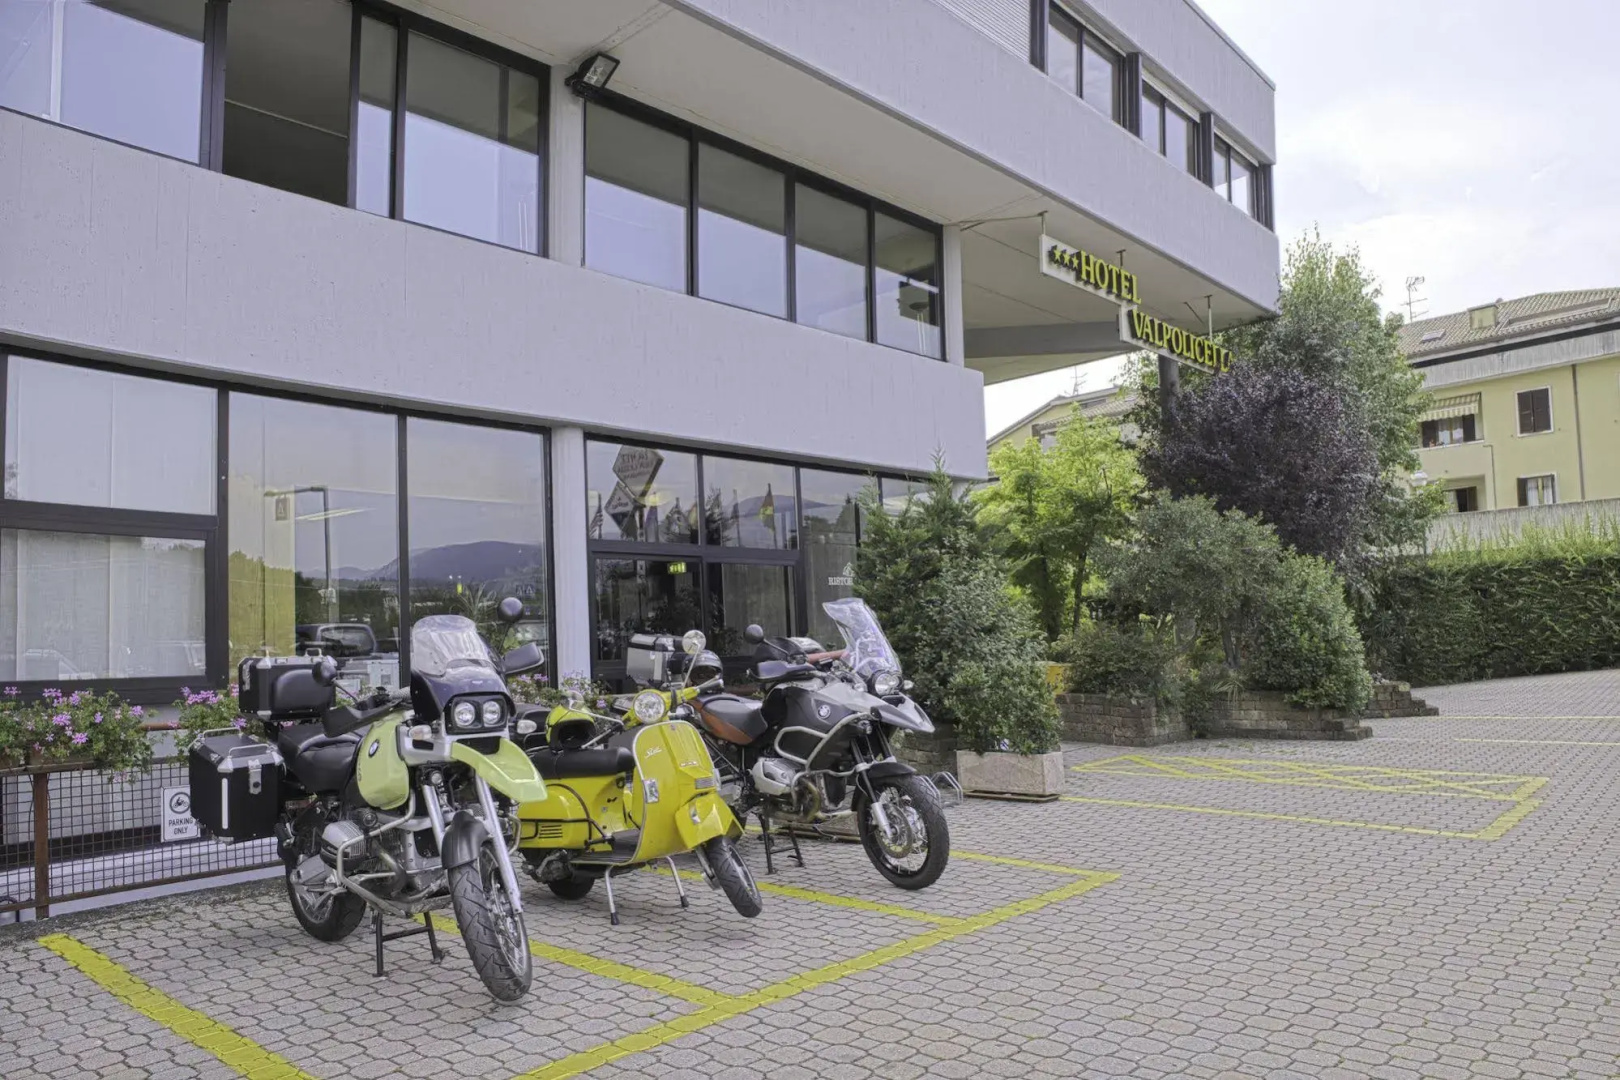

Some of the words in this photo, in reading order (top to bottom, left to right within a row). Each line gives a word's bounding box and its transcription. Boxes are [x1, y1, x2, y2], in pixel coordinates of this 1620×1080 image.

[1081, 250, 1141, 305] HOTEL
[168, 816, 193, 826] PARKING
[174, 825, 188, 835] ONLY
